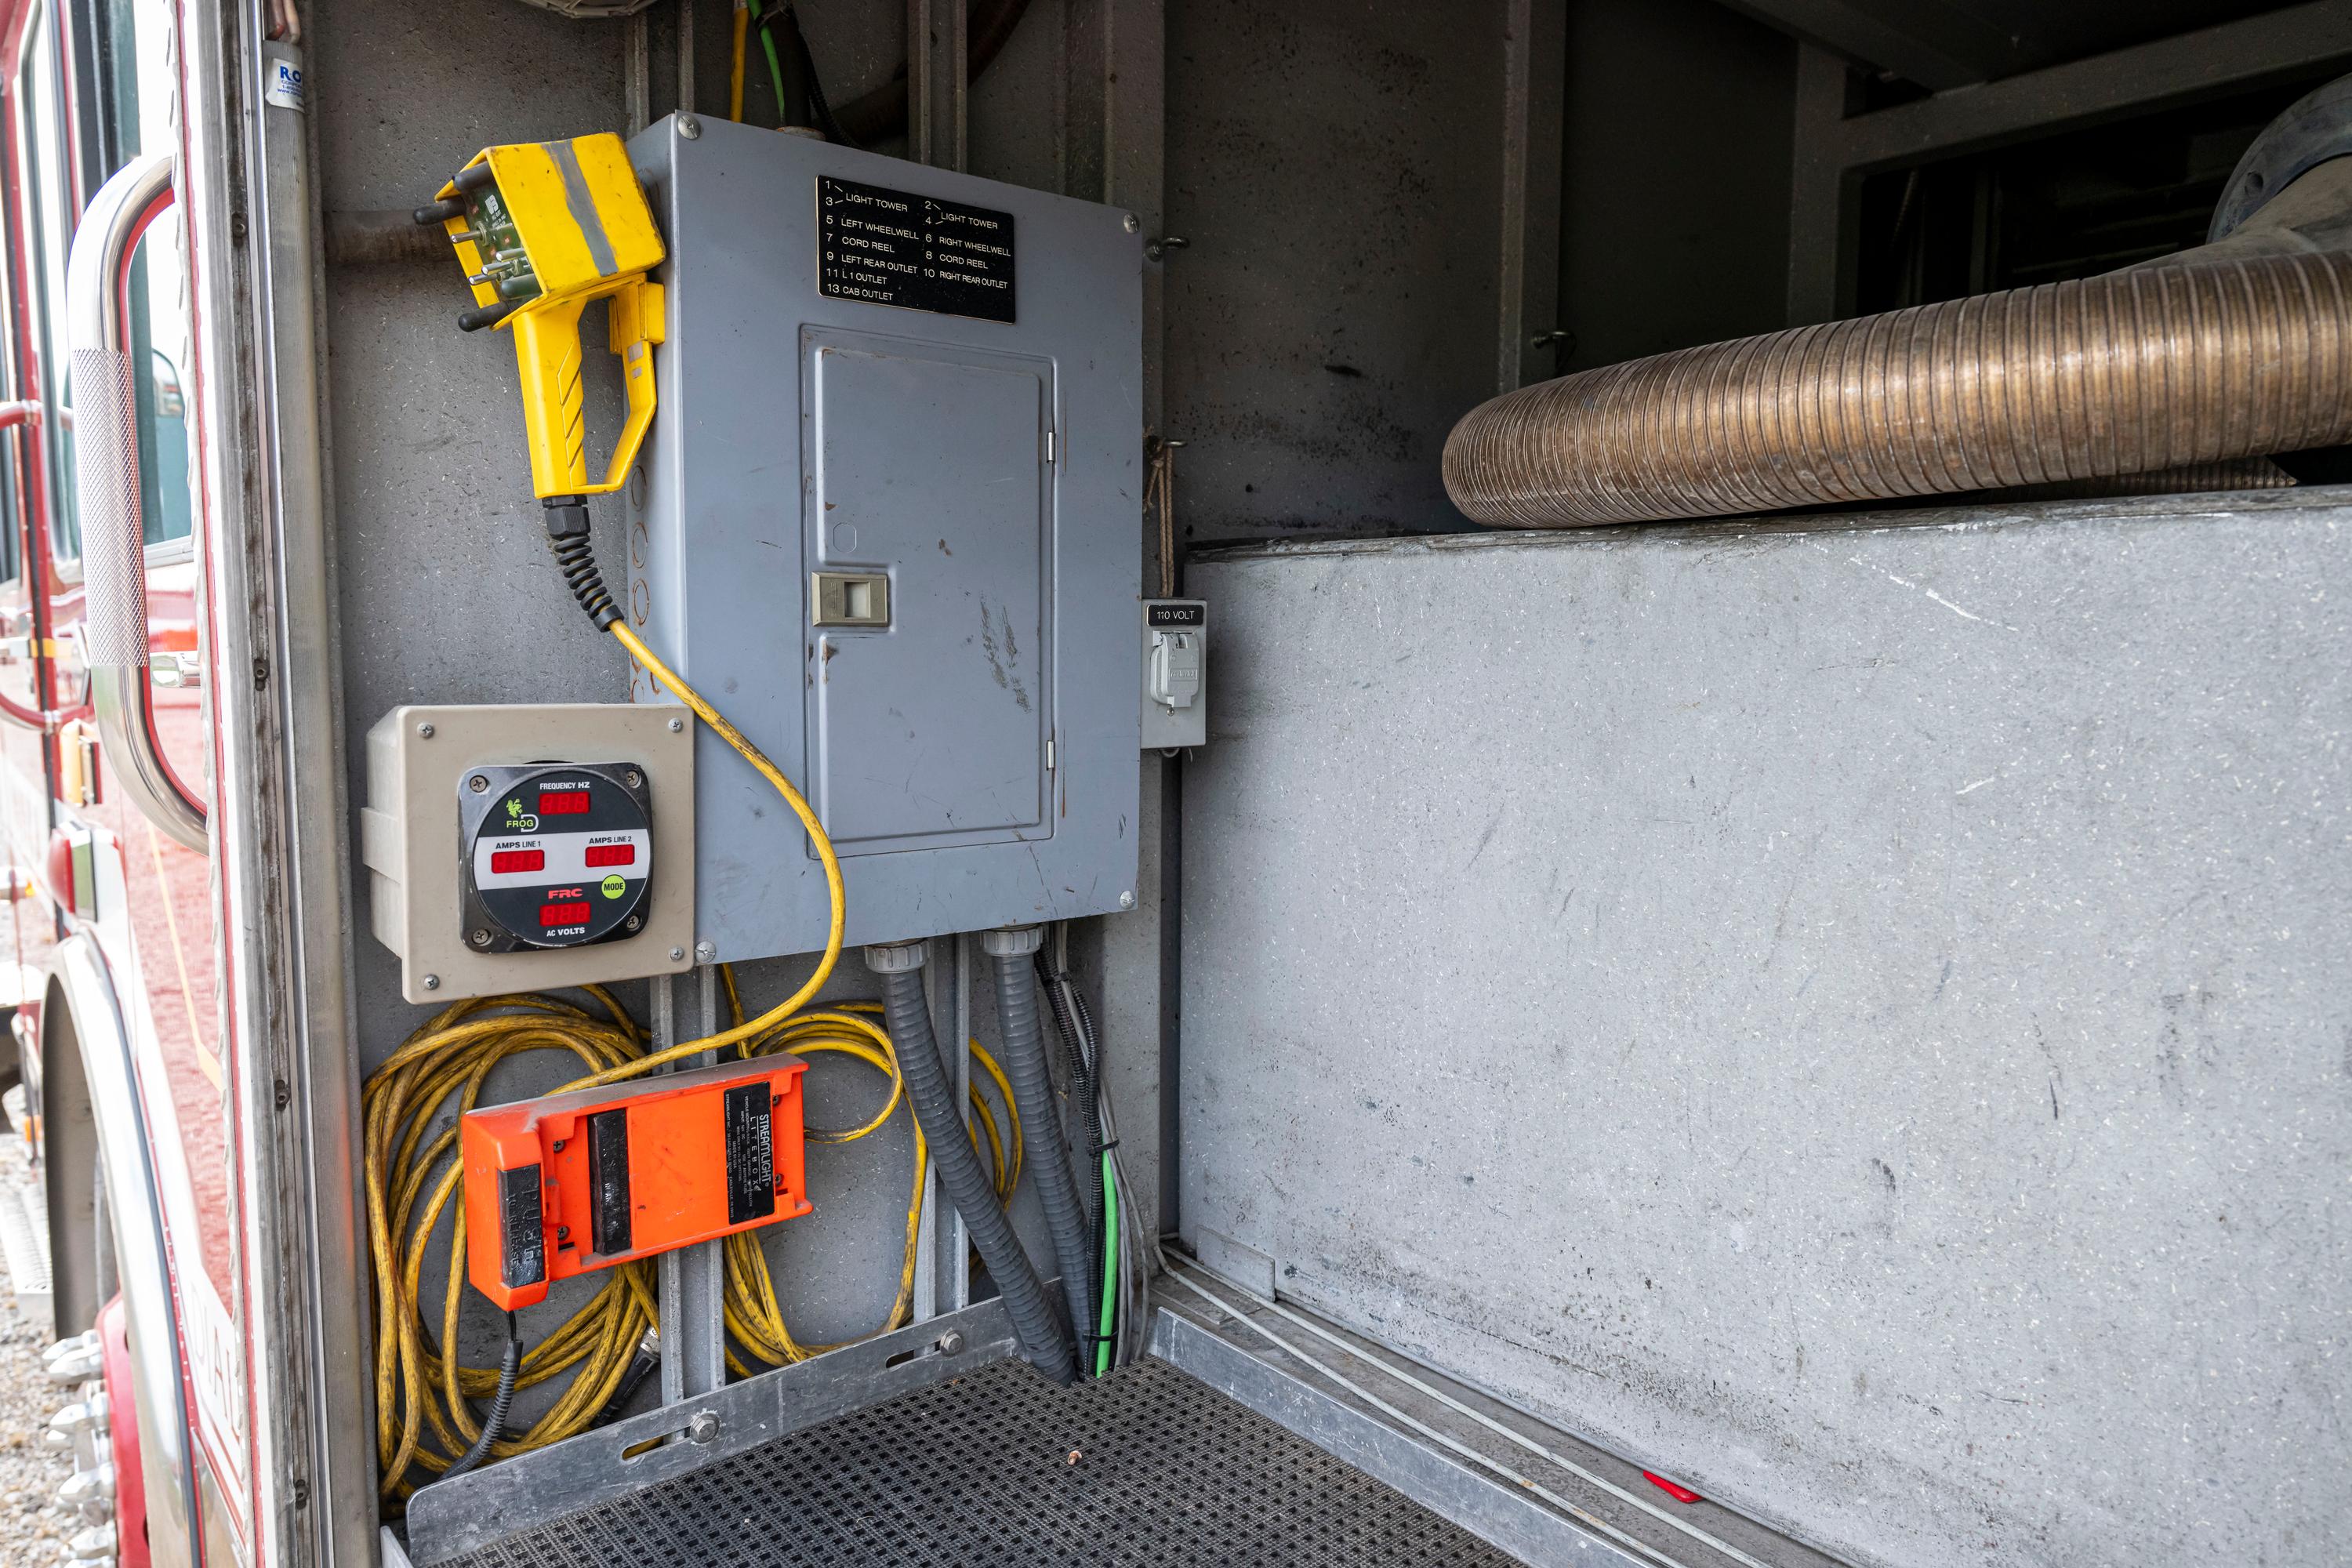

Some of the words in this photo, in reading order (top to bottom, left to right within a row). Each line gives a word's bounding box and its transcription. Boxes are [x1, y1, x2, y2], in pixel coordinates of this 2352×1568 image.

[826, 180, 830, 189] 1
[826, 197, 833, 205] 3
[845, 193, 873, 205] LIGHT
[876, 198, 908, 212] TOWER
[925, 201, 931, 209] 2
[826, 215, 833, 224] 5
[841, 218, 863, 229] LEFT
[865, 223, 920, 240] WHEELWELL
[925, 216, 931, 225] 4
[941, 212, 966, 223] LIGHT
[968, 217, 998, 230] TOWER
[826, 233, 833, 242] 7
[842, 237, 869, 248] CORD
[871, 241, 895, 252] REEL
[925, 234, 932, 242] 6
[939, 236, 963, 248] RIGHT
[964, 241, 1011, 257] WHEELWELL
[826, 251, 834, 260] 9
[841, 254, 862, 265] LEFT
[863, 258, 886, 268] REAR
[887, 262, 918, 274] OUTLET
[925, 251, 933, 260] 8
[939, 253, 964, 265] CORD
[966, 259, 989, 270] REEL
[826, 268, 838, 278] 11
[855, 272, 887, 285] OUTLET
[923, 268, 935, 278] 10
[939, 270, 961, 281] RIGHT
[962, 274, 981, 285] REAR
[981, 278, 1008, 289] OUTLET
[827, 283, 840, 293] 13
[843, 286, 860, 296] CAB
[862, 289, 894, 301] OUTLET
[1156, 611, 1171, 620] 110
[1172, 611, 1196, 620] VOLT
[506, 819, 534, 828] FROG
[548, 887, 583, 899] FRC
[603, 882, 624, 891] MODE
[558, 927, 586, 936] VOLTS
[759, 1113, 771, 1182] STREAMLIGHT
